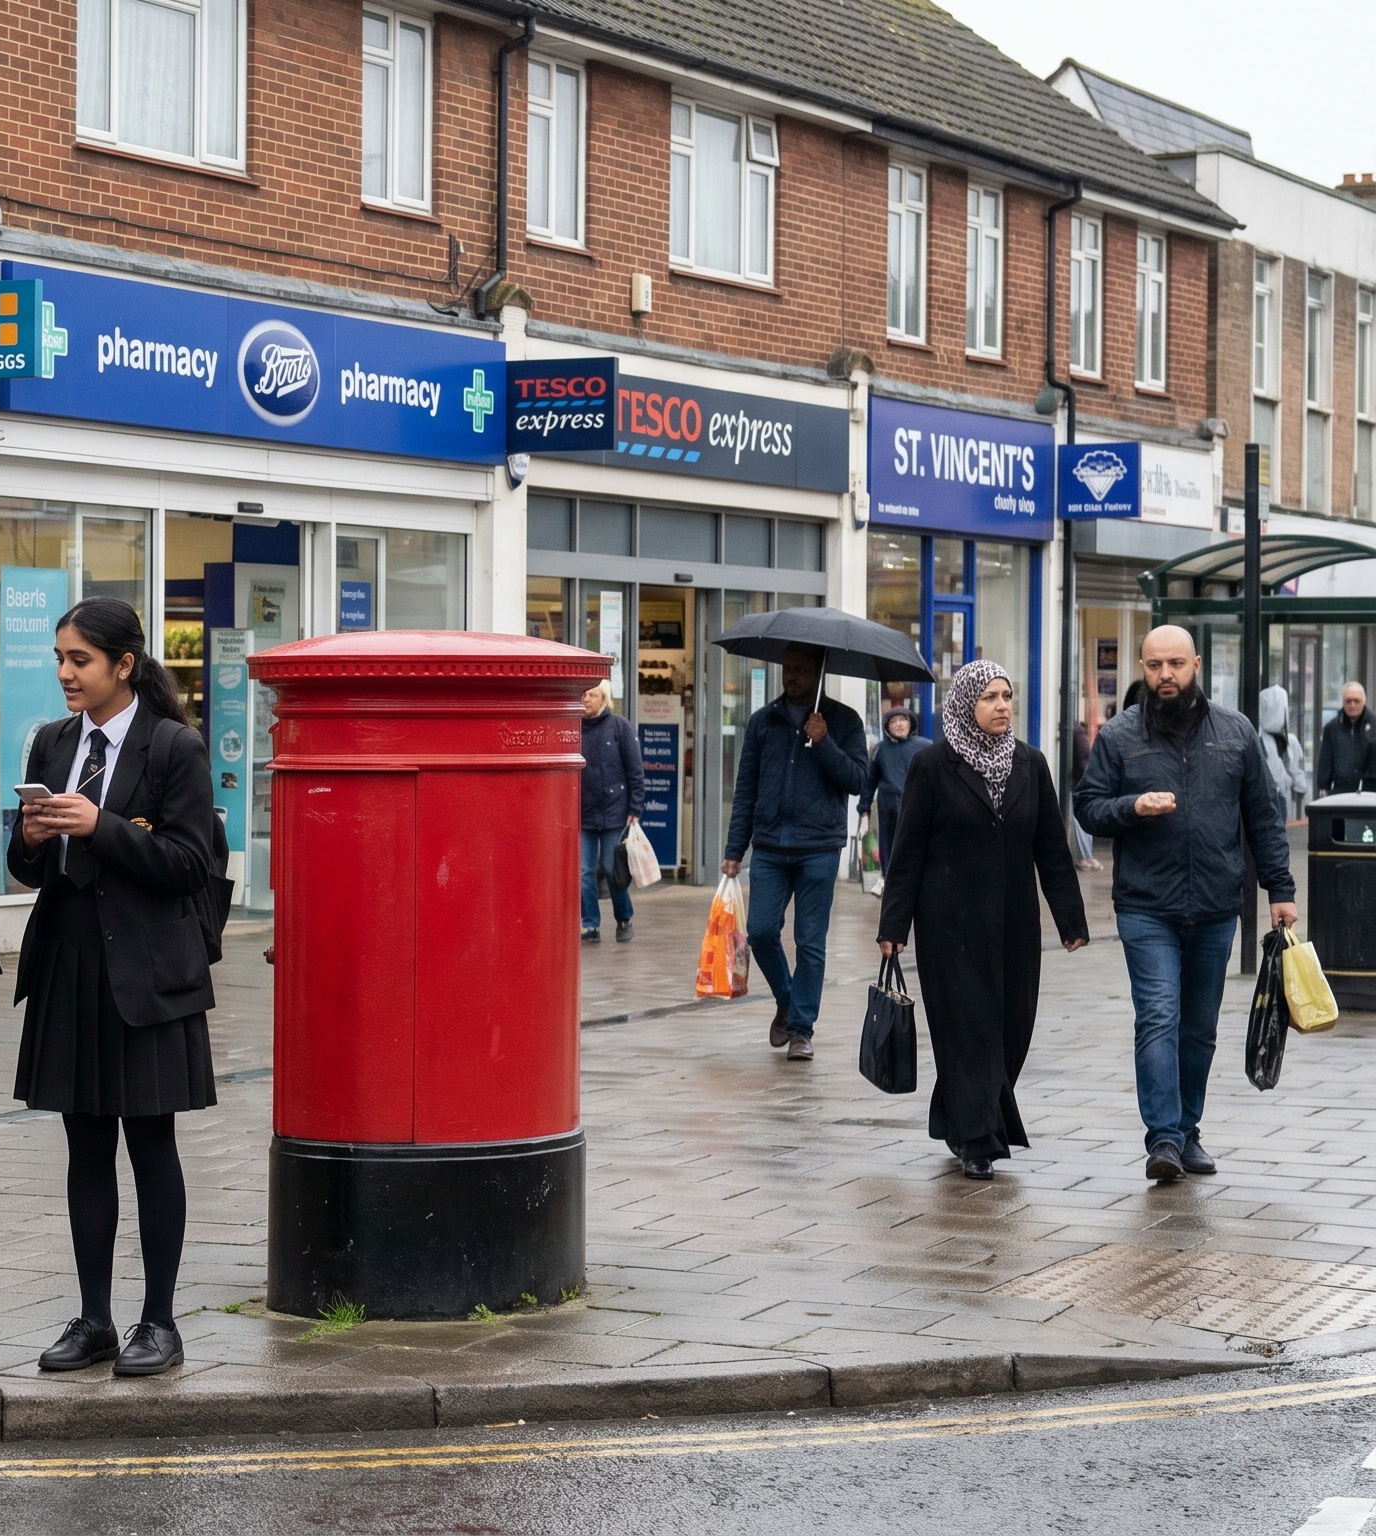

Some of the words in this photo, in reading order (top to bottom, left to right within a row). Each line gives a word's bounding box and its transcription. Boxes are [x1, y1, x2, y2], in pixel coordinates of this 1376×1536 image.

[98, 327, 218, 388] pharmacy
[254, 343, 312, 398] Boots
[341, 362, 441, 417] pharmacy
[515, 376, 606, 398] TESCO
[515, 410, 605, 437] express
[709, 409, 793, 465] express
[894, 427, 925, 477] ST.
[930, 433, 1035, 492] VINCENT'S
